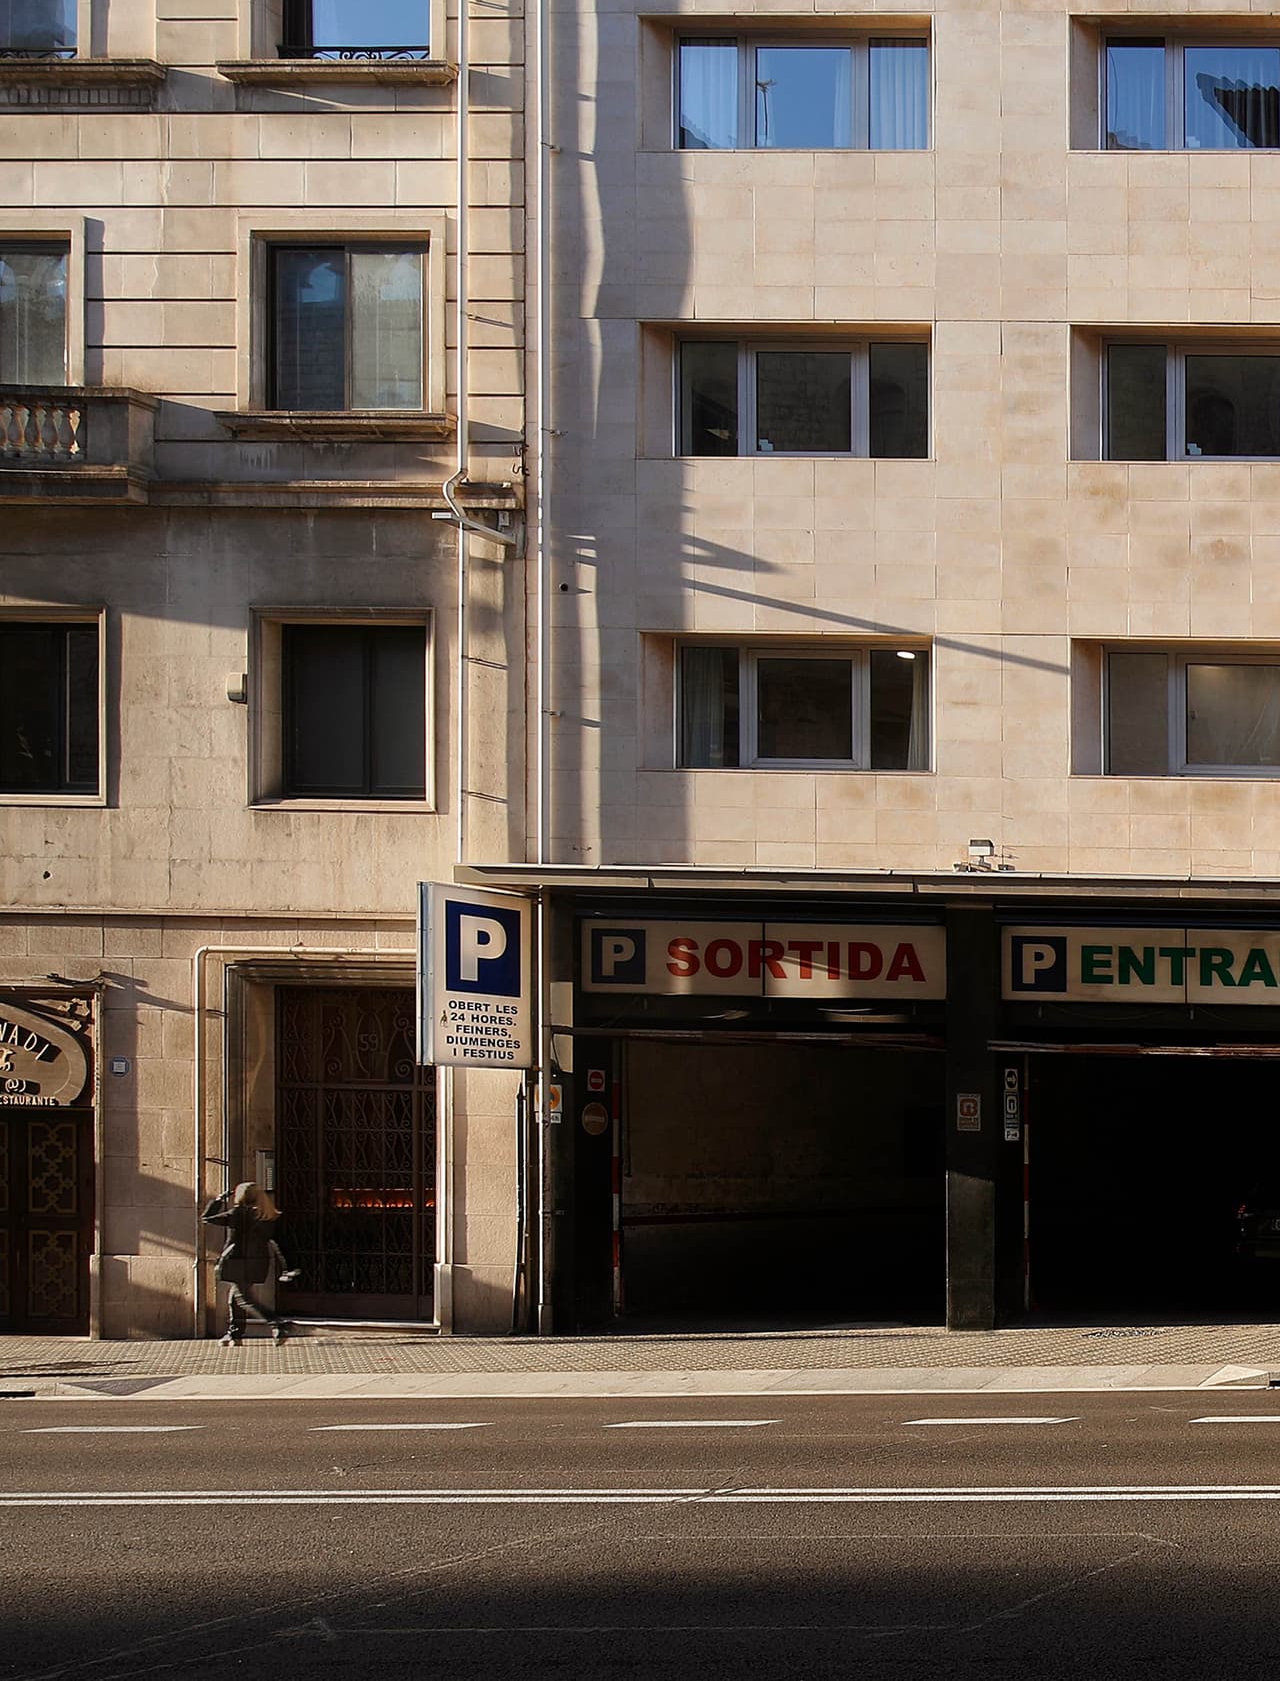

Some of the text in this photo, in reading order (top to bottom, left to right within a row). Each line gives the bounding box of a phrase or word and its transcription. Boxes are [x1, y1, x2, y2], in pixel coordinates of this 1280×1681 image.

[460, 914, 507, 982] P
[601, 936, 927, 982] P SORTIDA
[1022, 943, 1057, 985] P
[448, 1001, 518, 1015] OBERT LES
[450, 1012, 517, 1026] 24 HORES.
[456, 1025, 512, 1038] FEINERS,
[446, 1035, 521, 1049] DIUMENGES
[463, 1048, 515, 1060] FESTIUS
